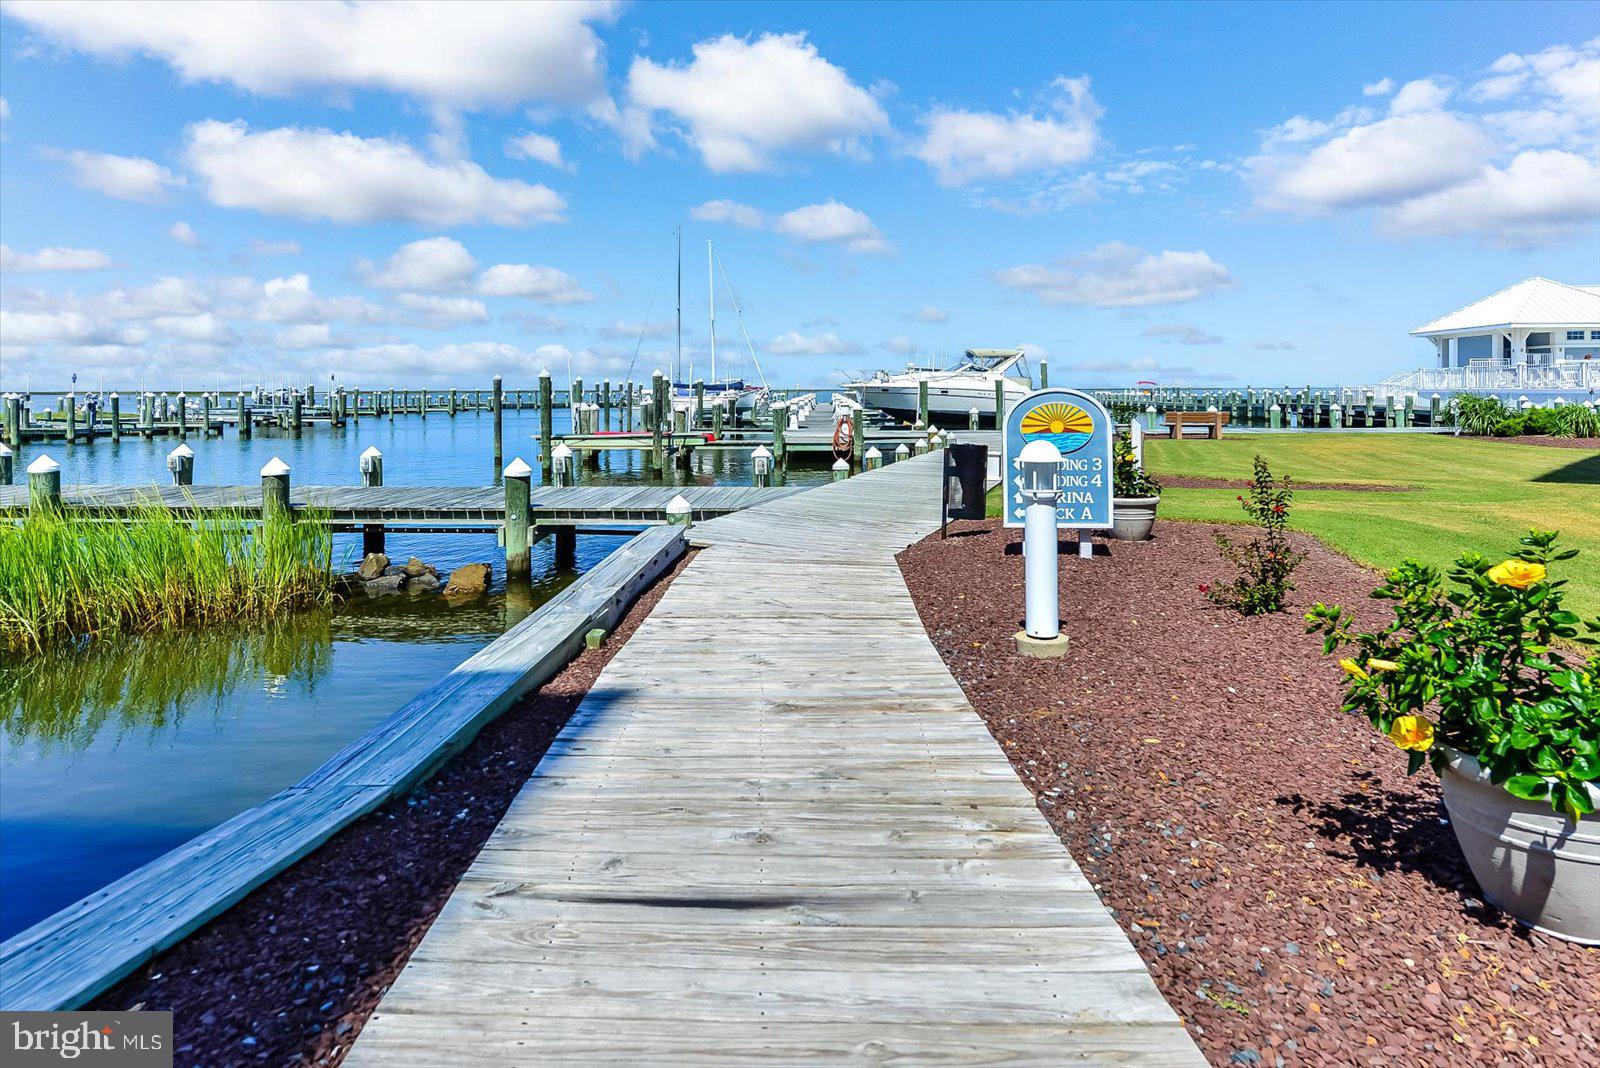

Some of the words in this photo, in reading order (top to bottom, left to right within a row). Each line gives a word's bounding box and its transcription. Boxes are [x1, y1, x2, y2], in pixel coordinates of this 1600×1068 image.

[1057, 459, 1088, 471] DING
[1092, 457, 1103, 471] 3
[1057, 475, 1088, 487] DING
[1091, 474, 1103, 487] 4
[1057, 491, 1094, 504] RINA
[1056, 508, 1075, 520] CK
[1081, 507, 1093, 520] A
